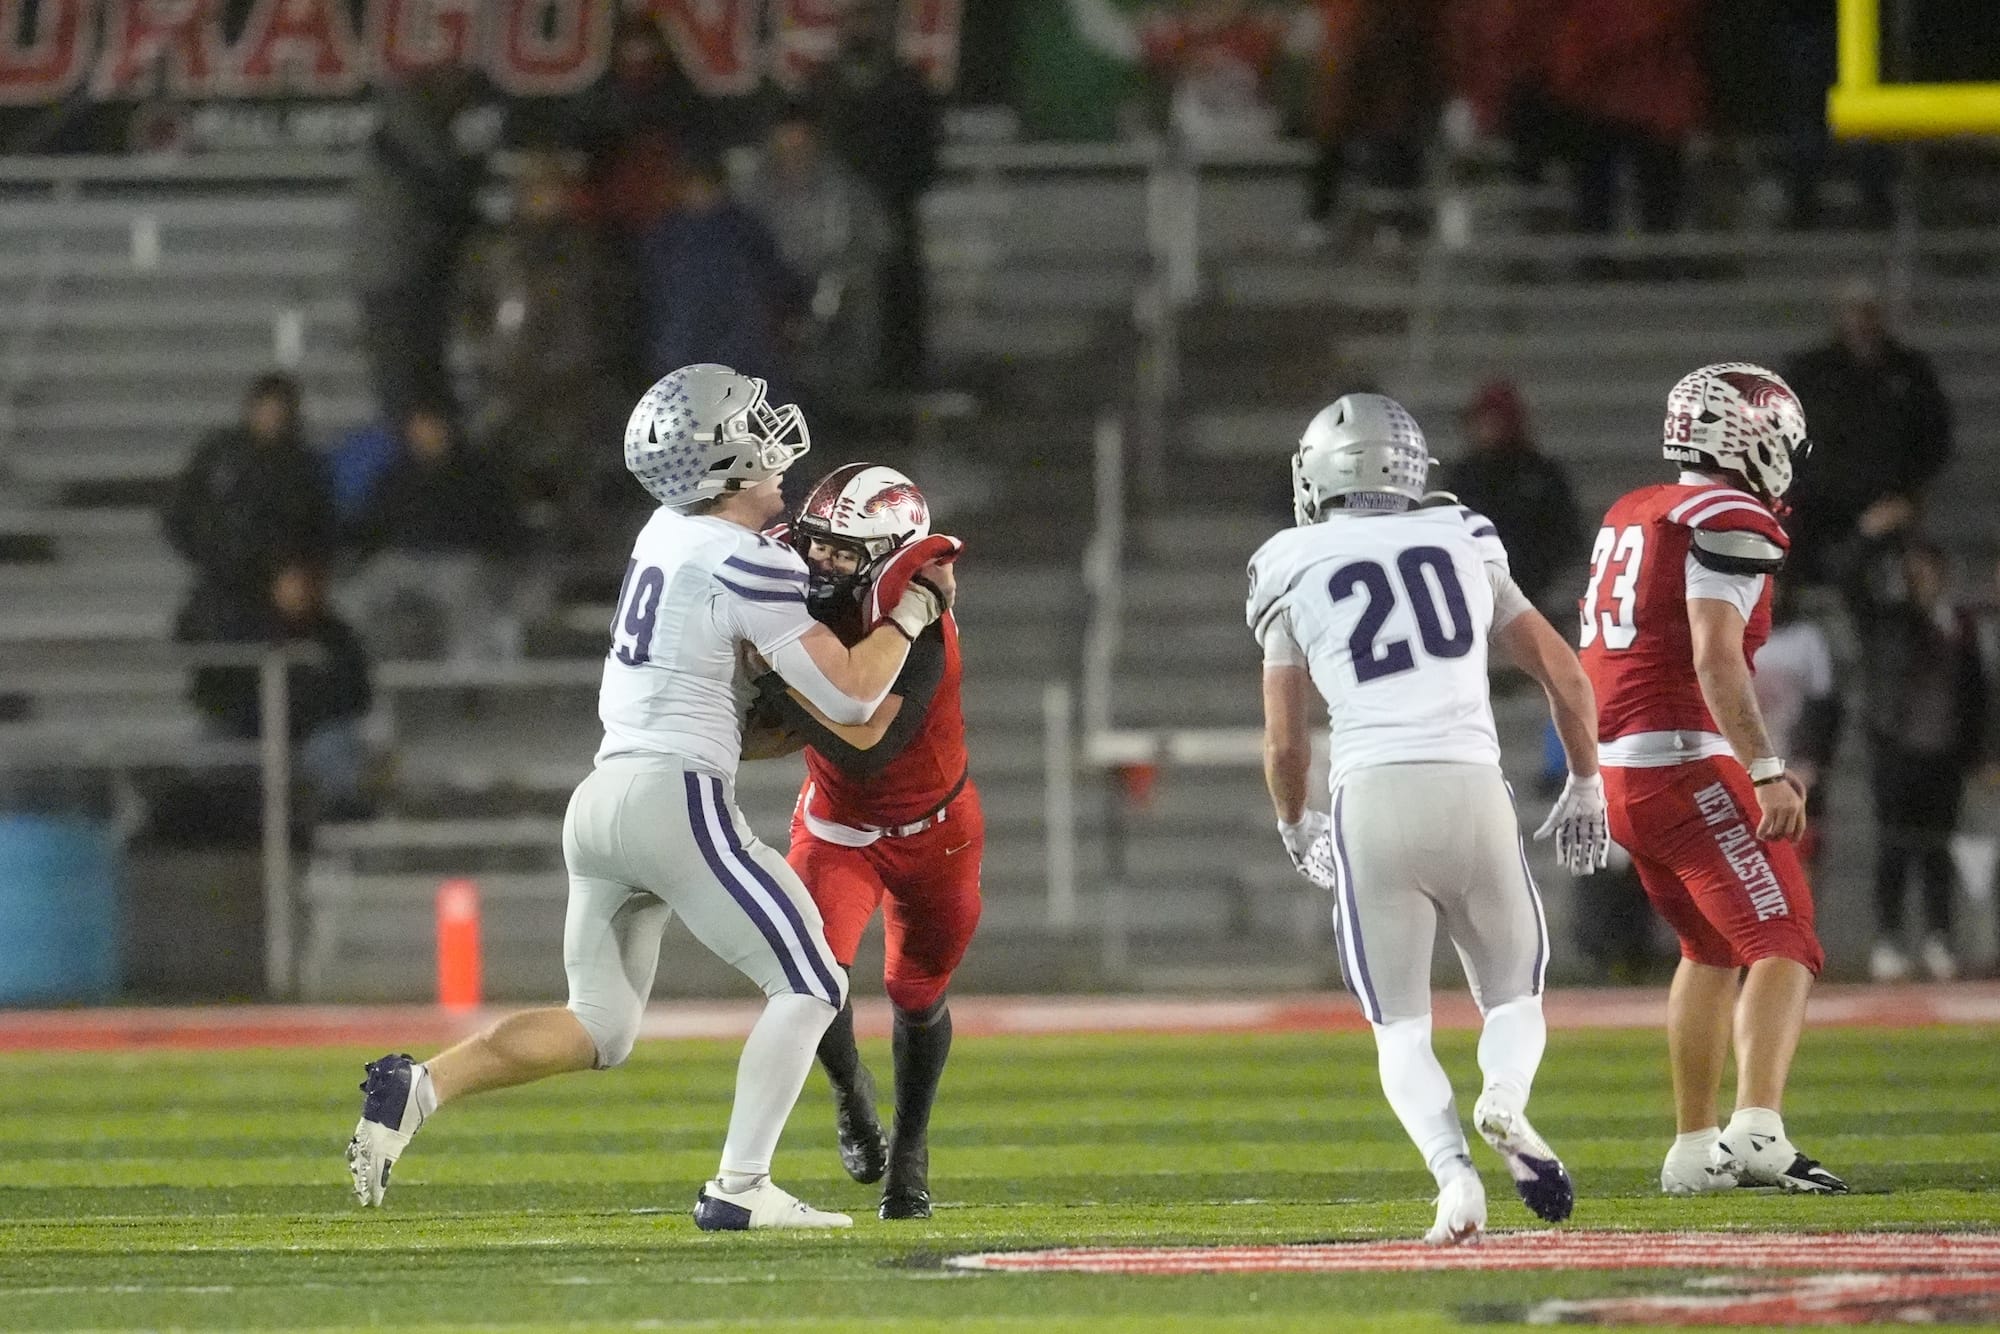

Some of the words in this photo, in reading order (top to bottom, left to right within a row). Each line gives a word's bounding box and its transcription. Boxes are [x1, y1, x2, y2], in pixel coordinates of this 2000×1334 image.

[1664, 411, 1692, 443] 33
[610, 558, 665, 667] 19
[1328, 546, 1473, 684] 20
[1579, 524, 1645, 649] 33
[1693, 781, 1739, 826] NEW
[1714, 823, 1789, 922] PALESTINE
